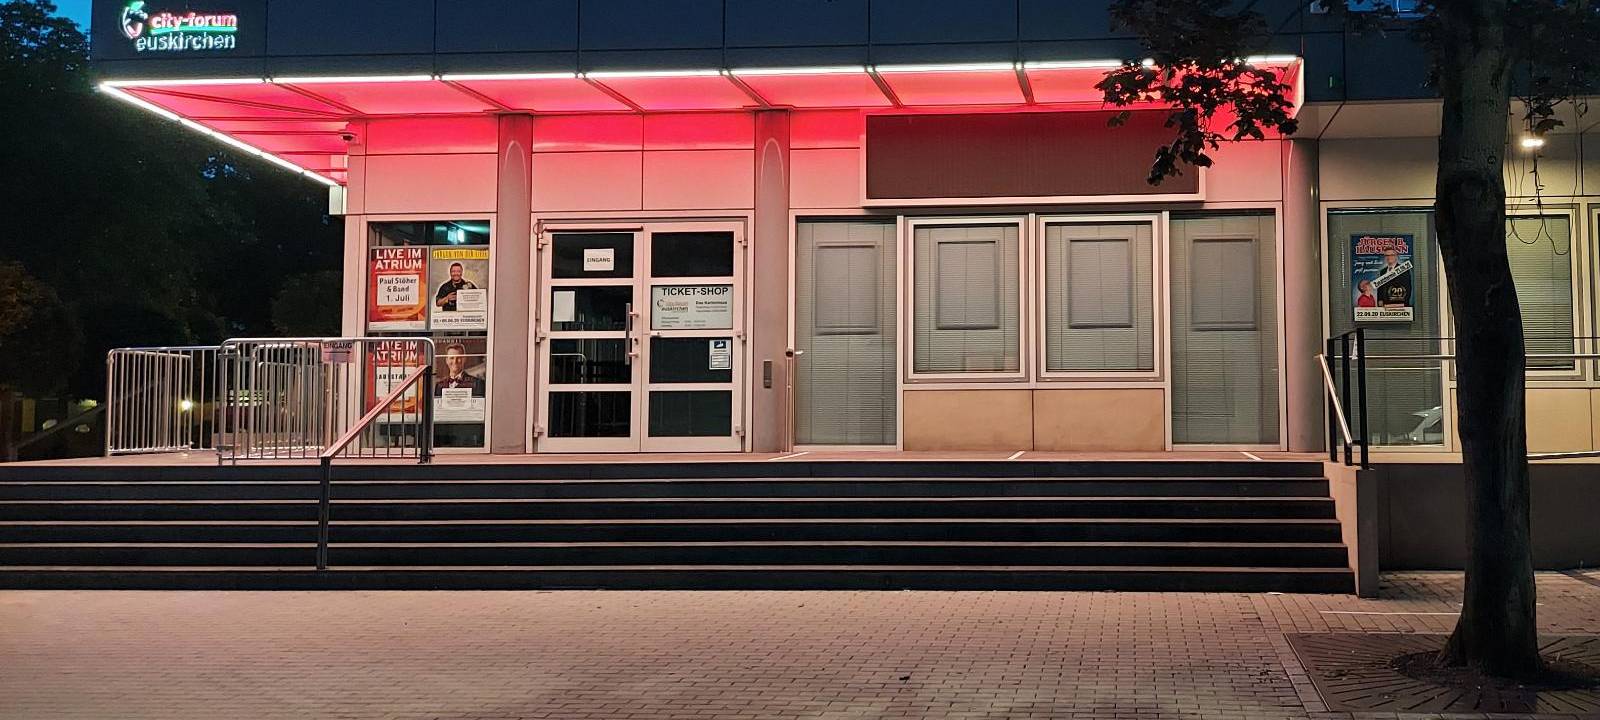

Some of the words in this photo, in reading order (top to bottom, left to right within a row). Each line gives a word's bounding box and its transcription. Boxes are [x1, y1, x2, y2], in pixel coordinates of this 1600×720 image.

[151, 12, 237, 30] city-forum
[136, 32, 236, 51] euskirchen
[376, 248, 404, 259] LIVE
[408, 248, 422, 259] IM
[375, 259, 422, 270] ATRIUM
[662, 287, 729, 296] TICKET-SHOP
[395, 294, 410, 302] Juli
